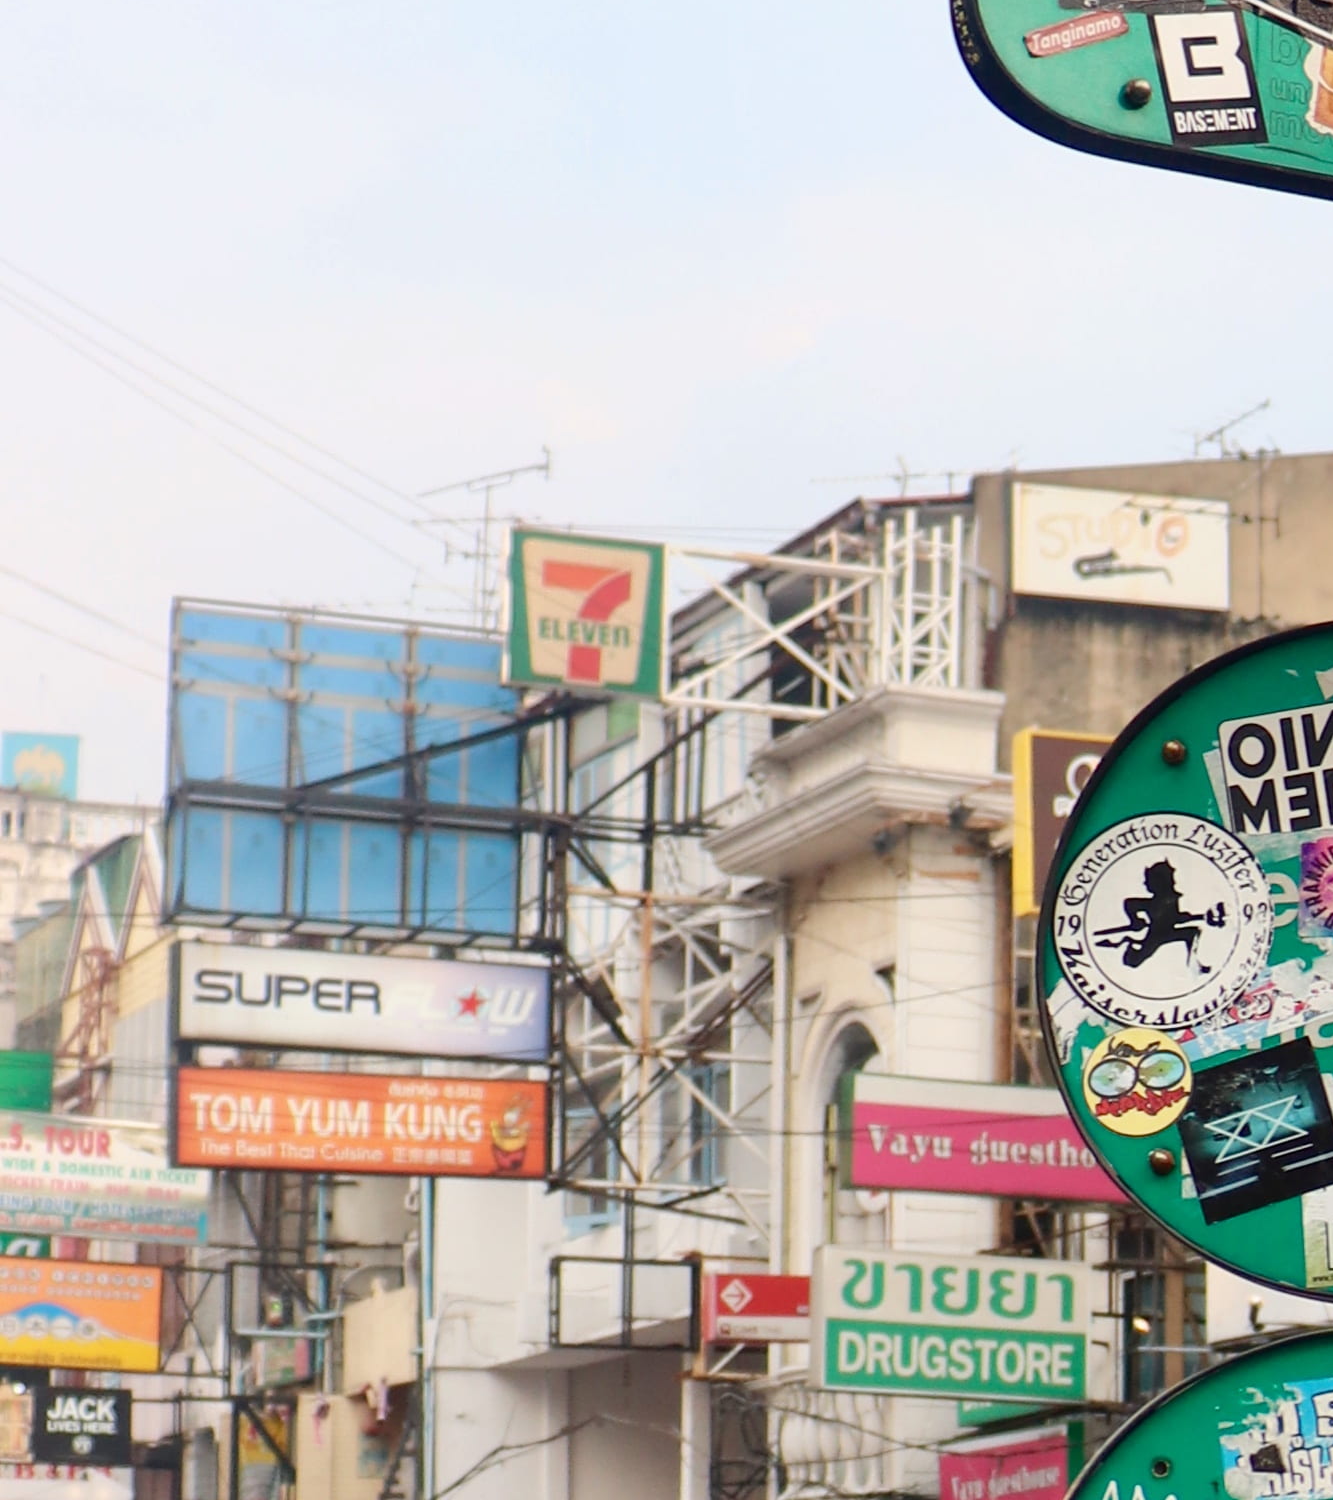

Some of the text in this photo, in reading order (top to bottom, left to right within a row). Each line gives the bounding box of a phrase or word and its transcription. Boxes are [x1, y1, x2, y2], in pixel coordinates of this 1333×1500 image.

[1174, 107, 1257, 134] BASEMENT
[541, 559, 633, 683] 7
[1075, 819, 1179, 909] Generation
[1057, 914, 1080, 936] 19
[192, 968, 382, 1016] SUPER
[190, 1094, 484, 1145] TOM YUM KUNG
[43, 1127, 111, 1158] TOUR
[200, 1138, 235, 1161] The
[238, 1141, 274, 1163] Best
[278, 1142, 317, 1164] Thai
[320, 1144, 384, 1166] Cuisine
[867, 1124, 953, 1162] Vayu
[842, 1257, 1075, 1322] ขายยา
[838, 1331, 1075, 1386] DRUGSTORE
[46, 1396, 117, 1422] JACK
[46, 1420, 82, 1434] LIVES
